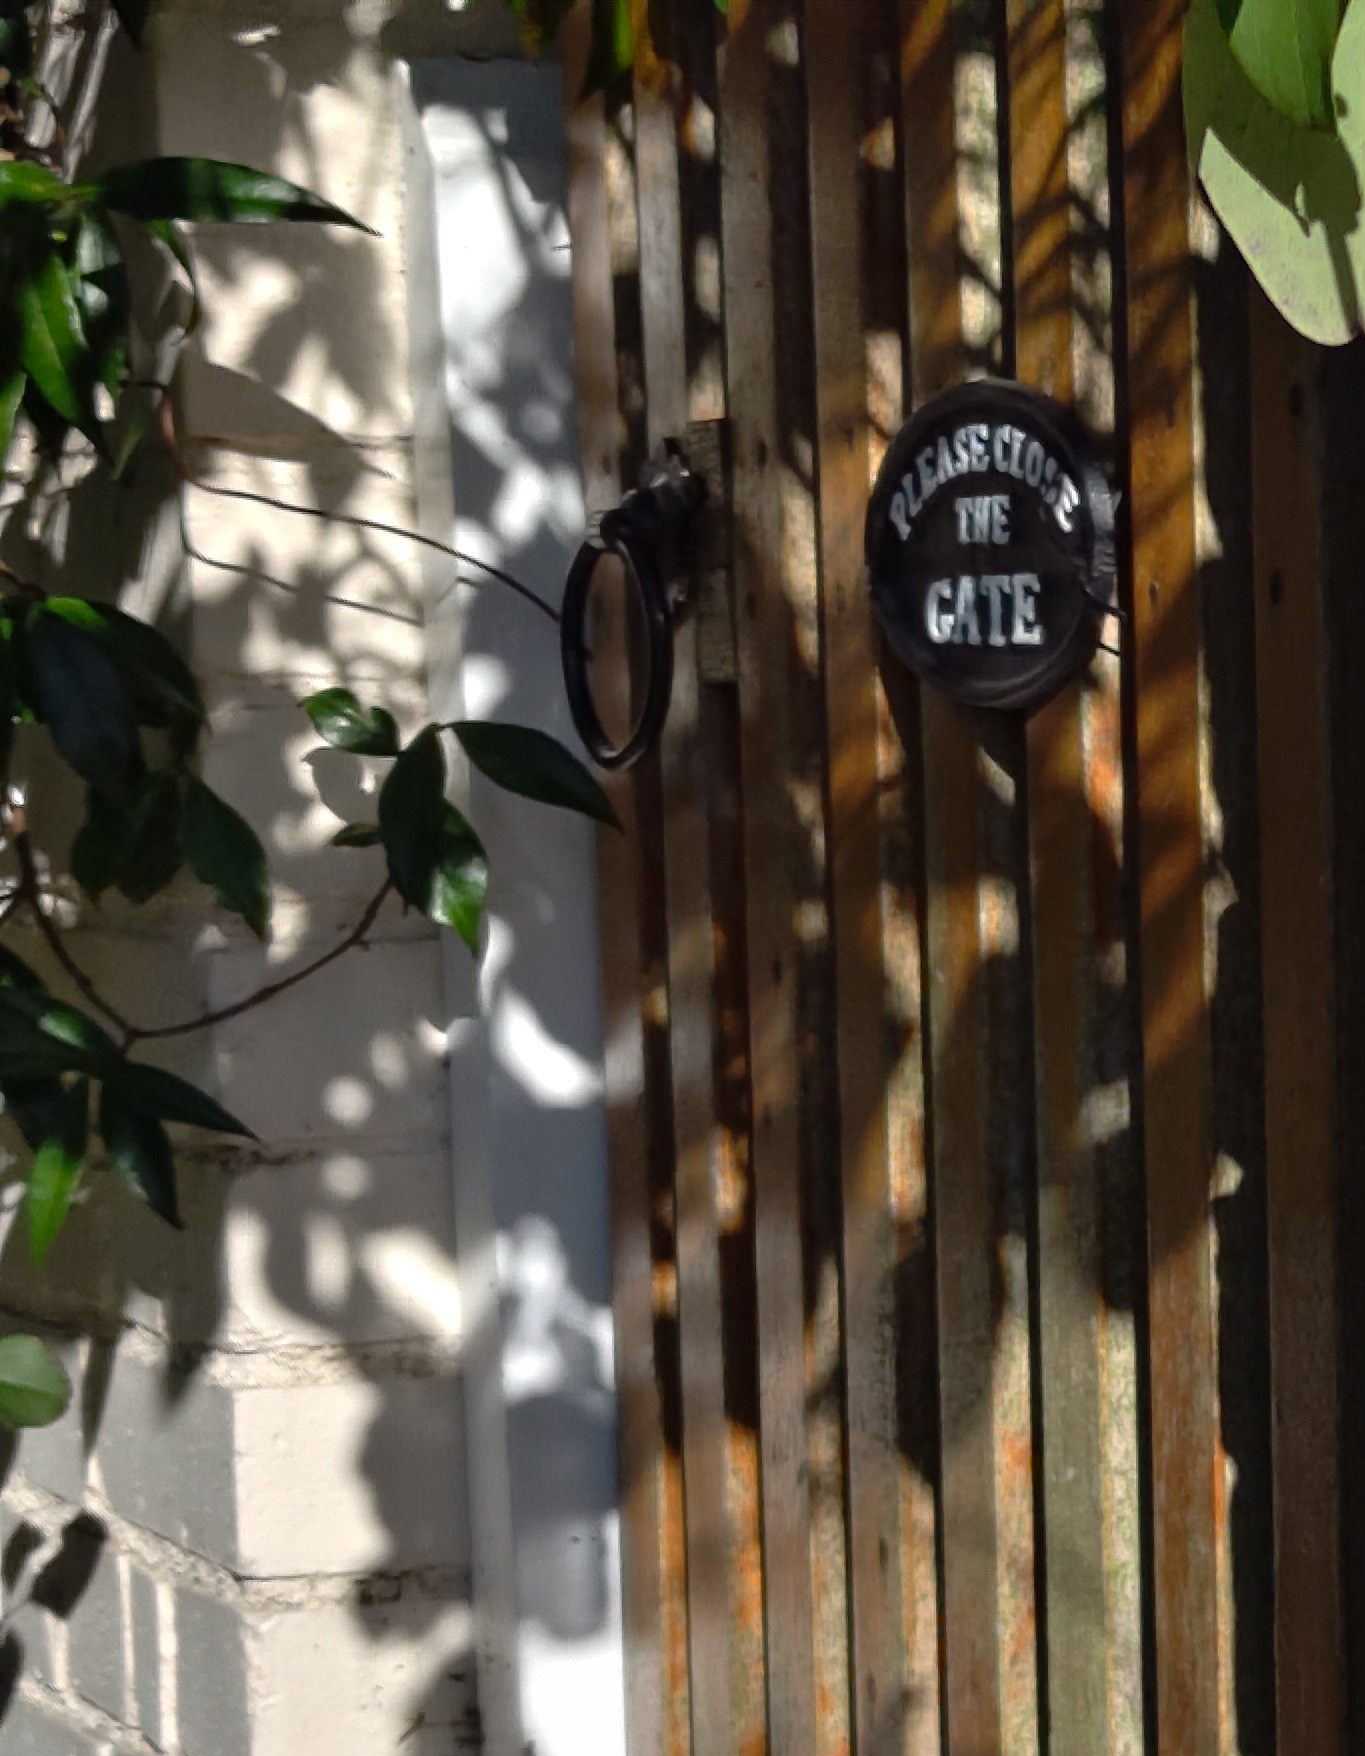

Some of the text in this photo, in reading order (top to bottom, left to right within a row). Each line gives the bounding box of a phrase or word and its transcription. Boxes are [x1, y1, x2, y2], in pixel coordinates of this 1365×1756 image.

[889, 423, 990, 541] PLEASE
[955, 494, 1011, 545] THE
[925, 572, 1043, 646] GATE
